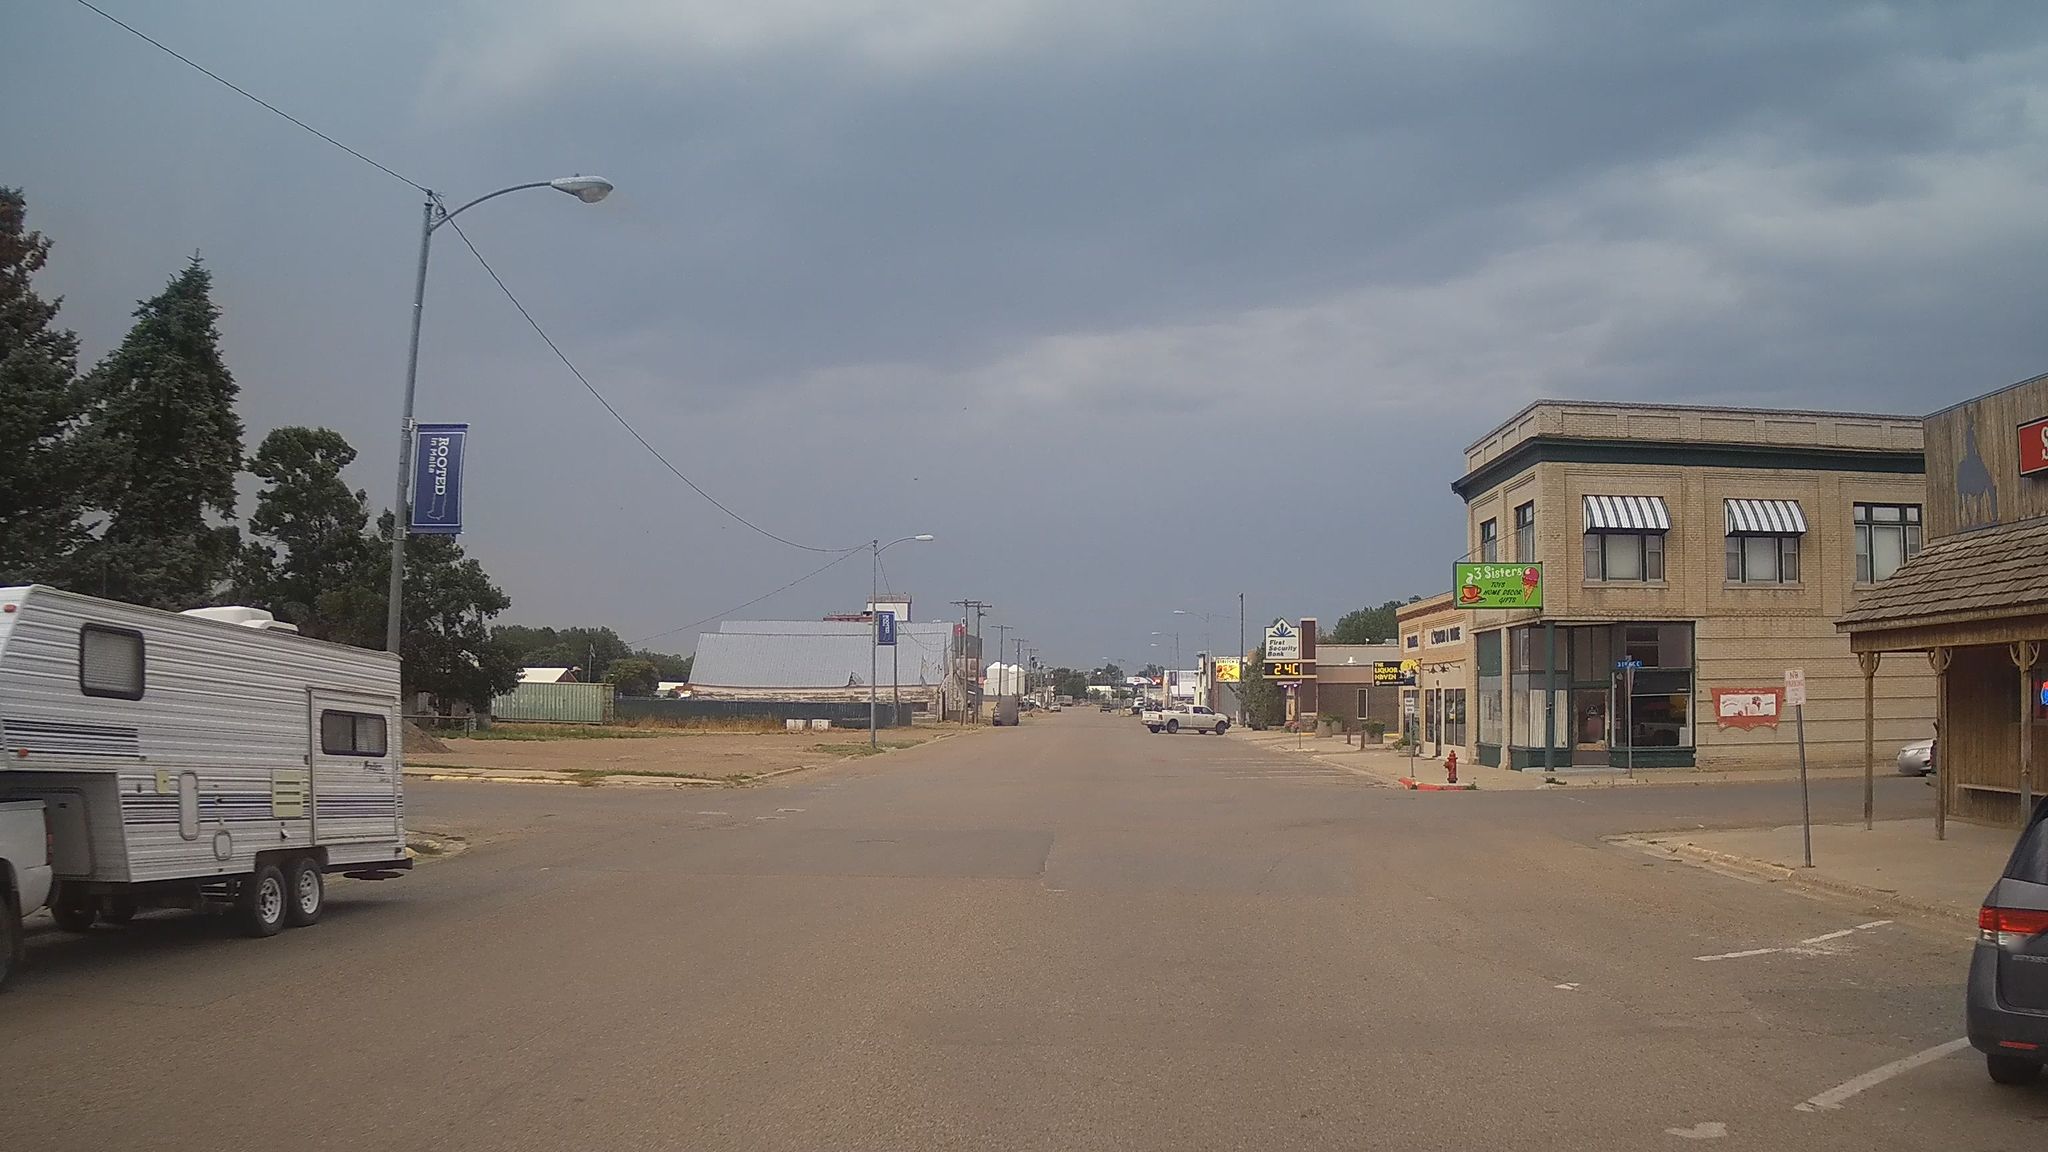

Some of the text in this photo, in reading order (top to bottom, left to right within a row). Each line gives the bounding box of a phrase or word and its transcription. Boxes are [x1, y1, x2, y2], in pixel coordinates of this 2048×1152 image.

[435, 437, 449, 495] ROOTED
[1474, 565, 1522, 580] 3 Sisters
